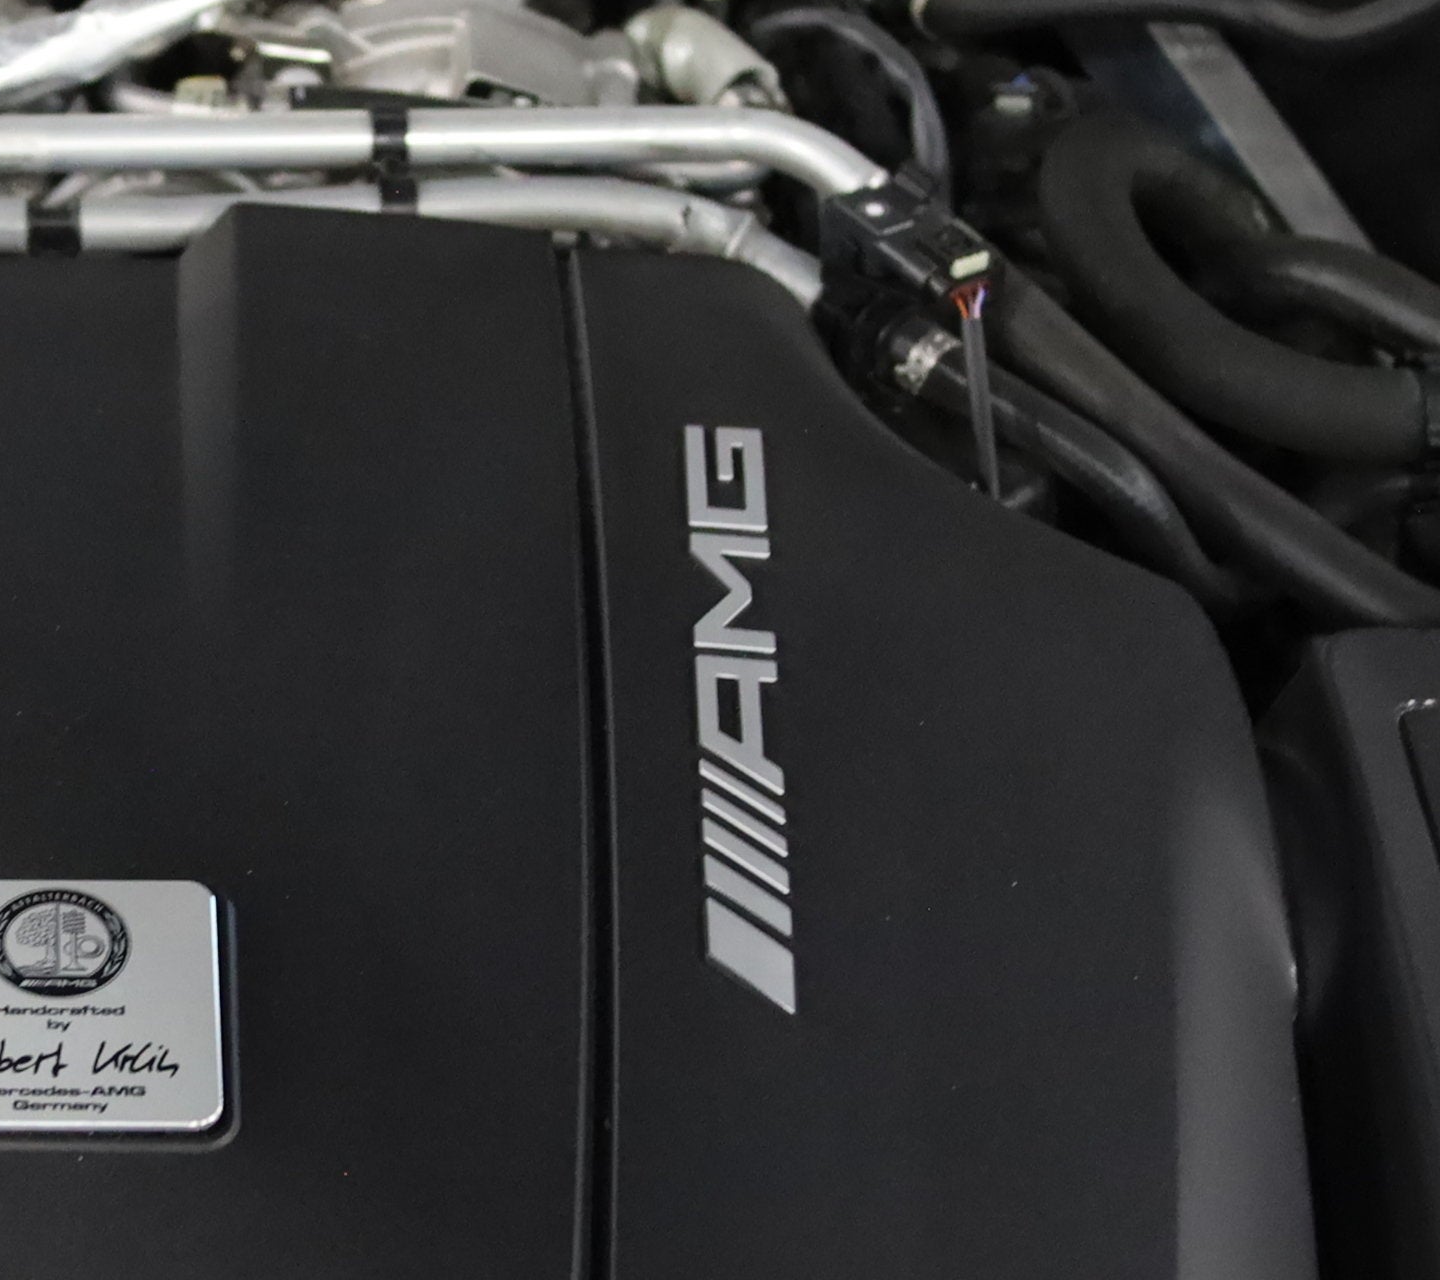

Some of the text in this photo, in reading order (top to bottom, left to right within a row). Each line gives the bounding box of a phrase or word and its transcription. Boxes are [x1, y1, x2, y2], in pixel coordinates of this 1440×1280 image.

[684, 424, 785, 796] AMG
[46, 1019, 72, 1032] by
[12, 1099, 108, 1113] Germany
